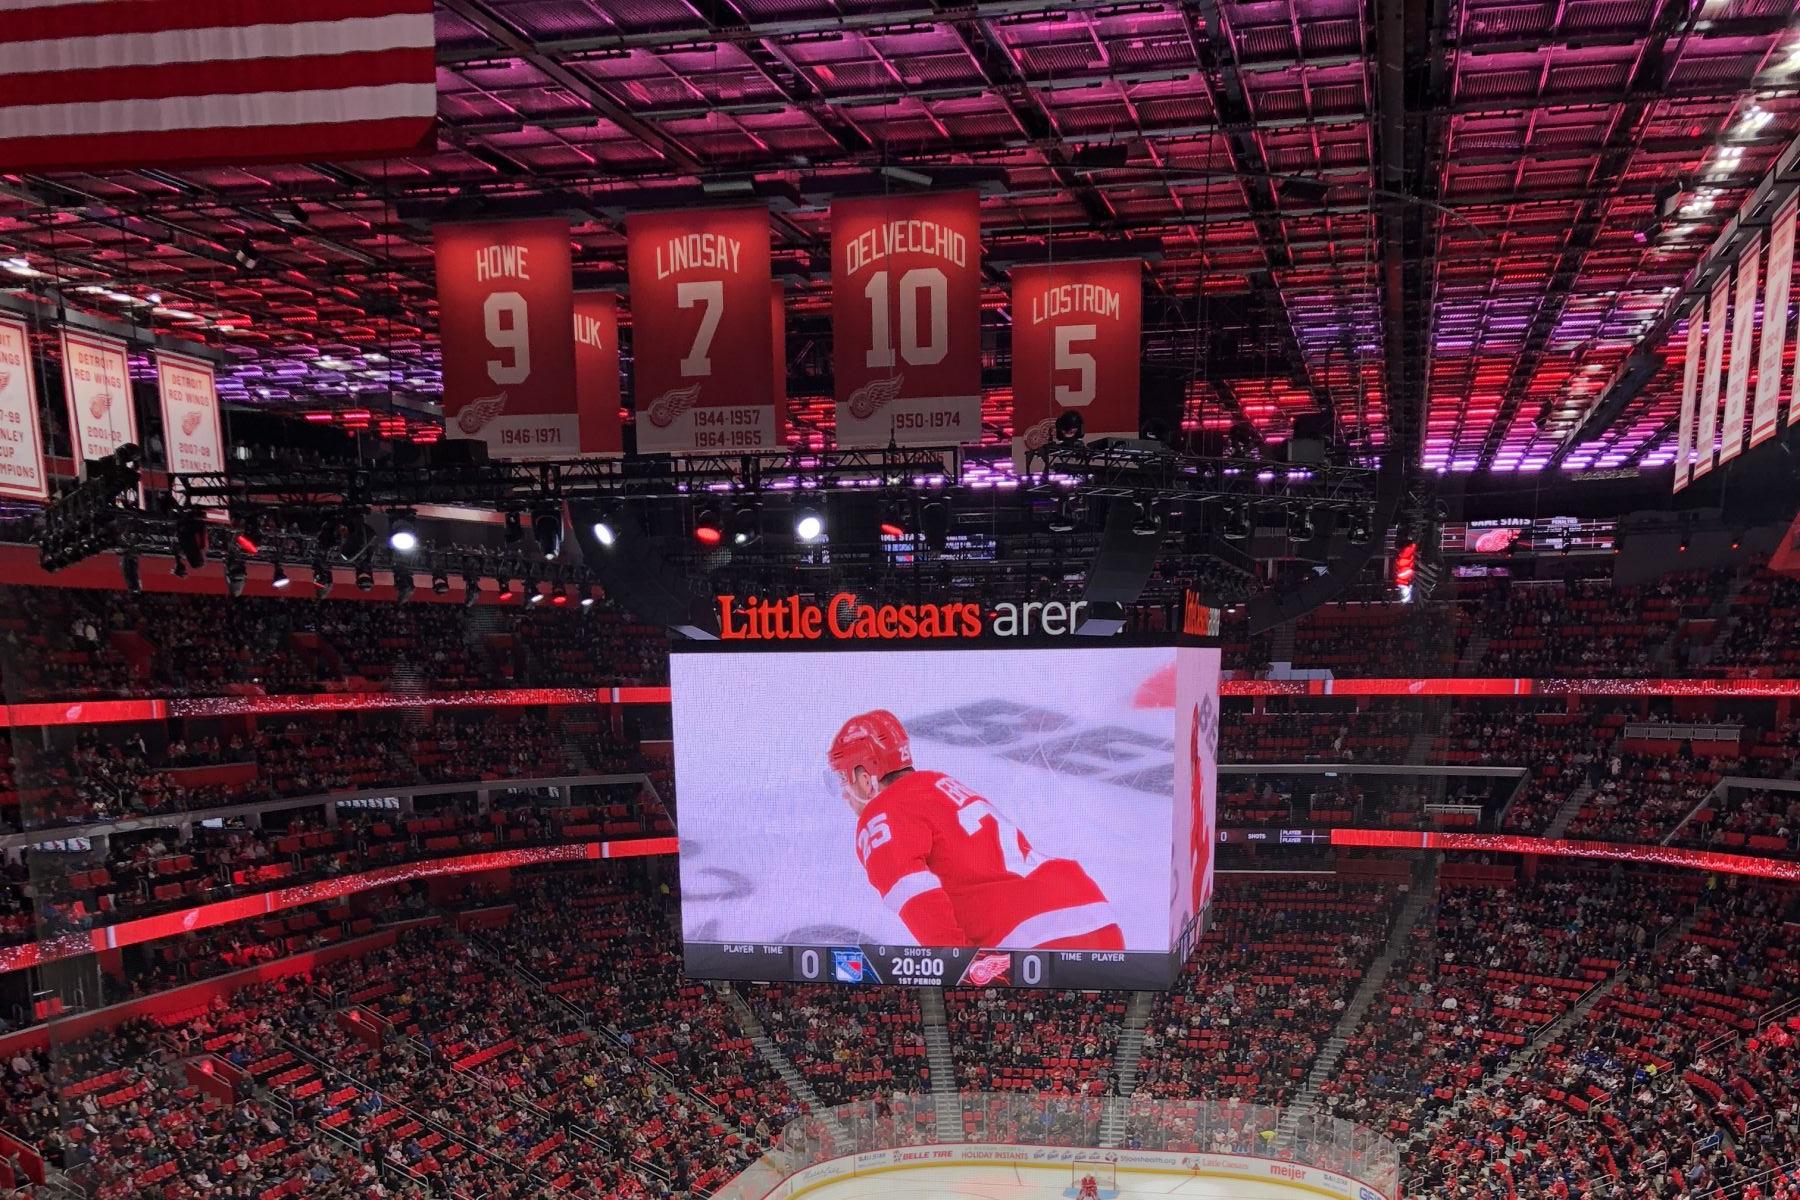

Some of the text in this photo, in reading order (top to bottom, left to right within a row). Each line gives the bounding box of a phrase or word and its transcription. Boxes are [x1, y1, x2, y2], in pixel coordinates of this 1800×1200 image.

[656, 233, 741, 281] LINDSAY
[846, 220, 966, 276] DELVECCHIO
[476, 246, 530, 282] HOWE
[865, 267, 948, 368] 10
[484, 291, 531, 384] 9
[677, 280, 723, 377] 7
[78, 351, 114, 371] DETROIT
[1055, 324, 1097, 407] 5
[74, 368, 122, 389] RED WINGS
[172, 373, 202, 391] DETROIT
[168, 389, 209, 407] RED WINGS
[694, 410, 761, 426] 1944-1957
[892, 411, 961, 429] 1950-1974
[87, 426, 122, 442] 2001-02
[500, 427, 561, 444] 1946-1971
[695, 430, 762, 447] 1964-1965
[717, 594, 822, 640] Little
[828, 591, 982, 639] Caesars
[723, 944, 783, 955] PLAYER TIME
[879, 946, 960, 958] 0 SHOTS 0
[1060, 952, 1125, 962] TIME PLAYER
[801, 949, 820, 979] 0
[891, 957, 944, 977] 20:00
[1022, 954, 1042, 985] 0
[898, 977, 942, 986] 1ST PERIOD
[903, 1150, 953, 1161] BELLE TIRE
[961, 1152, 993, 1160] HOLIDAY
[995, 1152, 1029, 1161] INSTANTS
[1270, 1164, 1307, 1180] meijer
